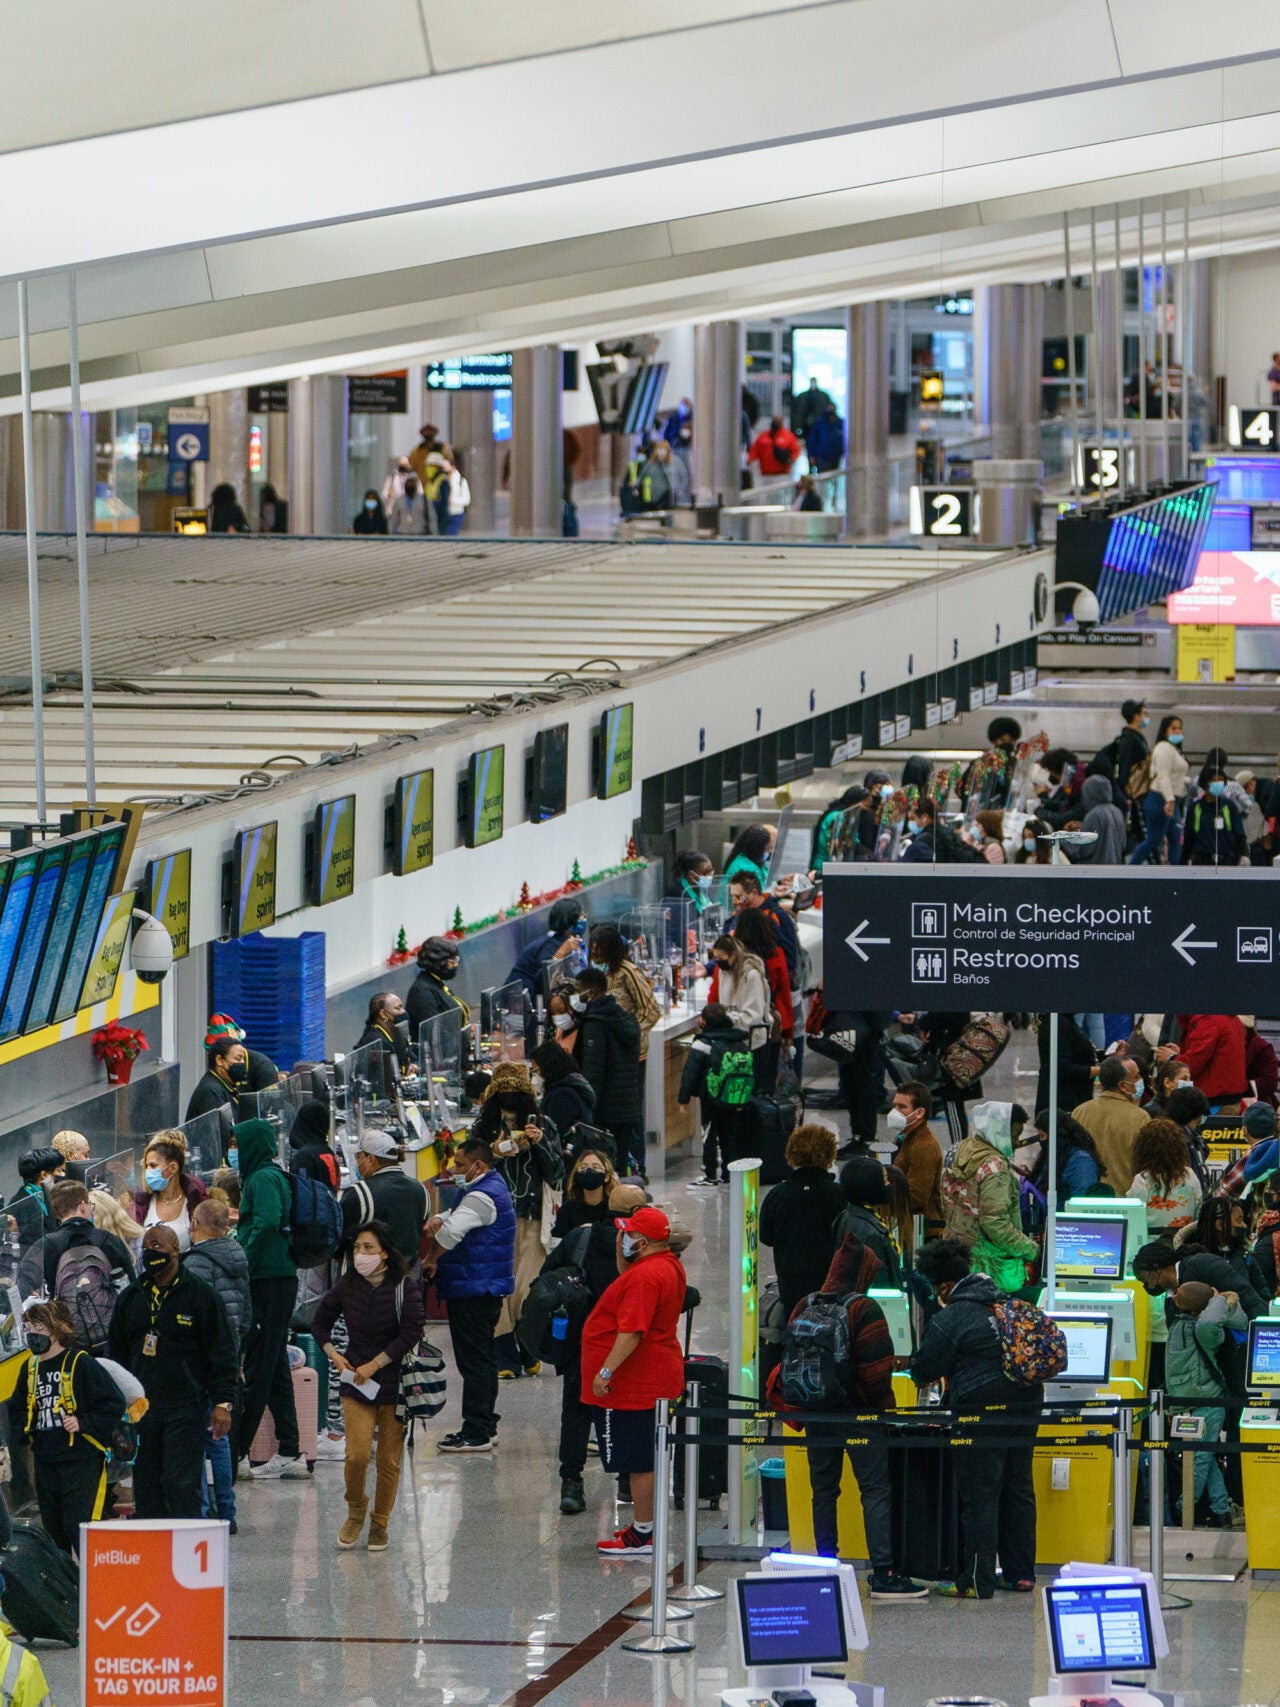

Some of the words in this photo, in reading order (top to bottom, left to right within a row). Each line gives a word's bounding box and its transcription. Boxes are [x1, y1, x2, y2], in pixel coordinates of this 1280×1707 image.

[1245, 412, 1273, 445] 4
[1090, 450, 1118, 486] 3
[931, 494, 962, 535] 2
[1069, 634, 1087, 645] Play
[1089, 635, 1101, 643] On
[1103, 634, 1140, 644] Carousel
[488, 812, 502, 832] spirit
[416, 838, 432, 861] spirit
[256, 872, 264, 888] Bag
[264, 870, 274, 884] Drop
[336, 867, 352, 891] spirit
[168, 902, 177, 920] Bag
[177, 900, 188, 916] Drop
[256, 897, 274, 920] spirit
[953, 903, 1008, 922] Main
[1016, 904, 1152, 928] Checkpoint
[953, 928, 996, 940] Control
[1000, 928, 1016, 940] de
[1019, 928, 1081, 942] Seguridad
[1084, 929, 1135, 942] Principal
[102, 944, 112, 962] Bag
[953, 948, 1080, 968] Restrooms
[953, 973, 990, 985] Baños
[1201, 1128, 1245, 1142] spirit
[47, 1372, 60, 1382] YO
[985, 1404, 1007, 1412] spirit
[1085, 1400, 1106, 1408] spirit
[1249, 1400, 1271, 1408] spirit
[754, 1410, 777, 1418] spirit
[857, 1414, 878, 1422] spirit
[958, 1415, 981, 1423] spirit
[1061, 1416, 1083, 1424] spirit
[743, 1436, 765, 1444] spirit
[847, 1438, 869, 1446] spirit
[950, 1438, 974, 1446] spirit
[1055, 1437, 1078, 1446] spirit
[1144, 1440, 1169, 1449] spirit
[94, 1550, 140, 1568] jetBlue
[194, 1540, 208, 1573] 1
[94, 1658, 180, 1674] CHECK-IN
[184, 1661, 194, 1672] +
[94, 1678, 128, 1695] TAG
[132, 1678, 180, 1695] YOUR
[184, 1675, 218, 1694] BAG
